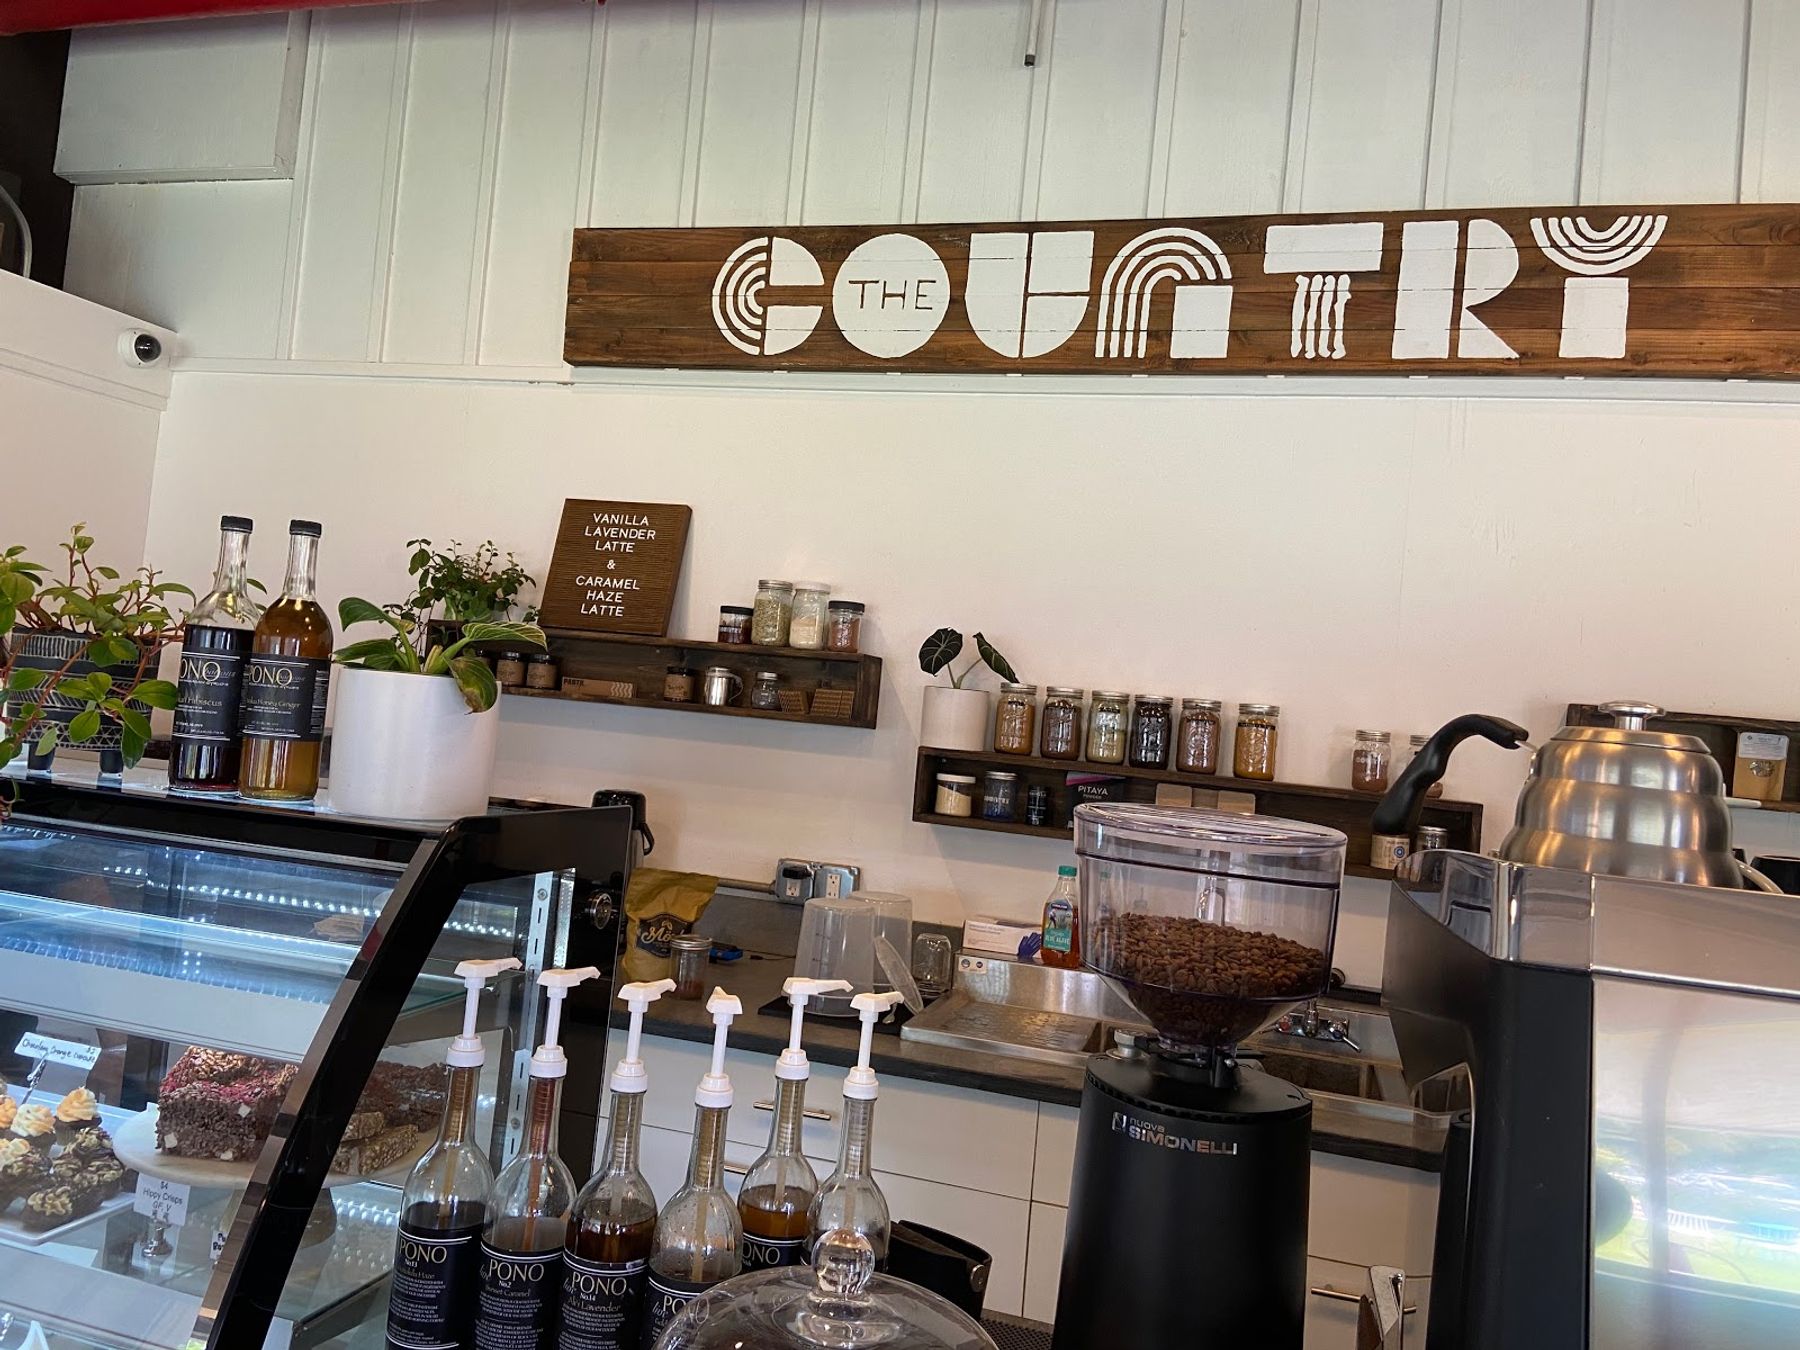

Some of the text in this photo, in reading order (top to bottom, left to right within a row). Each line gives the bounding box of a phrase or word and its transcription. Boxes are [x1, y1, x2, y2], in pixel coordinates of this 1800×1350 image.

[711, 214, 1669, 360] COUNTRY
[847, 279, 936, 311] THE
[593, 513, 649, 526] VANILLA
[584, 526, 656, 540] LAVENDER
[595, 540, 635, 553] LATTE
[606, 559, 616, 570] &
[575, 575, 641, 590] CARAMEL
[586, 590, 624, 603] HAZE
[580, 603, 625, 617] LATTE
[180, 658, 220, 682] ONO
[1078, 785, 1108, 796] PITAYA
[1129, 1118, 1165, 1133] nuova
[1128, 1125, 1238, 1156] SIMONELLI
[143, 1187, 161, 1200] Hippy
[743, 1240, 780, 1265] ONO
[489, 1258, 545, 1282] PONO
[572, 1271, 627, 1296] PONO
[581, 1301, 621, 1312] Lavender
